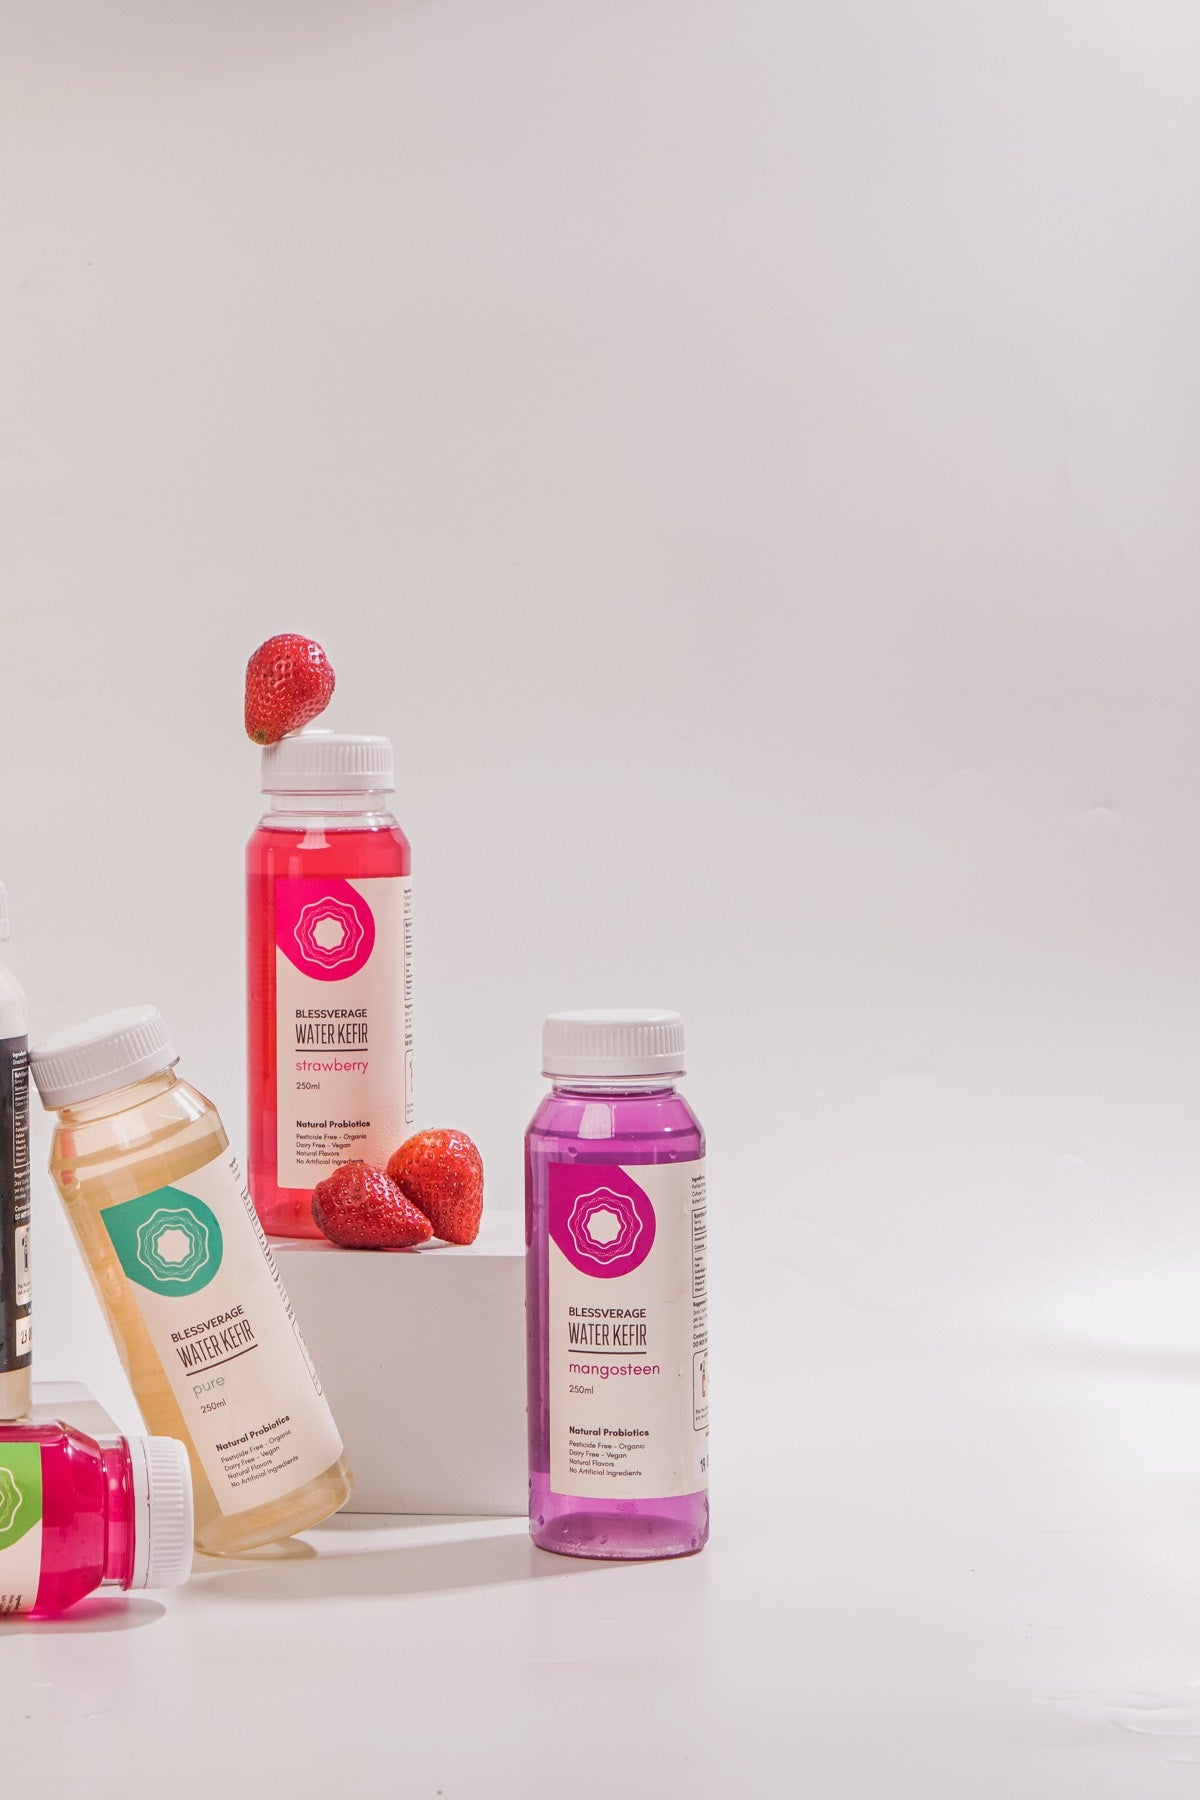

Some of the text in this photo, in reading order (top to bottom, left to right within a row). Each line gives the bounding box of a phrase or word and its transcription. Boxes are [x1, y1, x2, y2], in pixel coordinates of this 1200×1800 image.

[295, 1009, 367, 1018] BLESSVERAGE
[295, 1023, 368, 1044] WATER KEFIR
[295, 1058, 368, 1074] strawberry
[296, 1081, 320, 1090] 250ml
[296, 1120, 371, 1128] Natural Probiotics
[343, 1133, 367, 1141] Organic
[296, 1142, 311, 1150] Dairy
[568, 1306, 646, 1318] BLESSVERAGE
[171, 1304, 244, 1343] BLESSVERAGE
[568, 1321, 647, 1346] WATER KEFIR
[176, 1319, 255, 1368] WATER KEFIR
[569, 1363, 660, 1379] mangosteen
[193, 1376, 225, 1399] pure
[568, 1384, 594, 1394] 250ml
[200, 1398, 227, 1414] 250ml
[215, 1415, 290, 1452] Natural Probiotics
[569, 1426, 649, 1437] Natural Probiotics
[220, 1450, 248, 1463] Pesticide
[249, 1443, 264, 1454] Free
[268, 1429, 292, 1444] Organic
[569, 1440, 596, 1449] Pesticide
[618, 1443, 645, 1451] Organic
[224, 1462, 240, 1472] Dairy
[241, 1456, 255, 1466] Free
[260, 1445, 280, 1458] Vegan
[569, 1449, 584, 1457] Dairy
[585, 1450, 599, 1458] Free
[606, 1452, 627, 1460] Vegan
[569, 1458, 591, 1466] Natural
[227, 1459, 273, 1480] Natural Flavors
[231, 1455, 299, 1488] No Artificial Ingredients
[579, 1467, 605, 1476] Artificial
[606, 1469, 642, 1477] Ingredients
